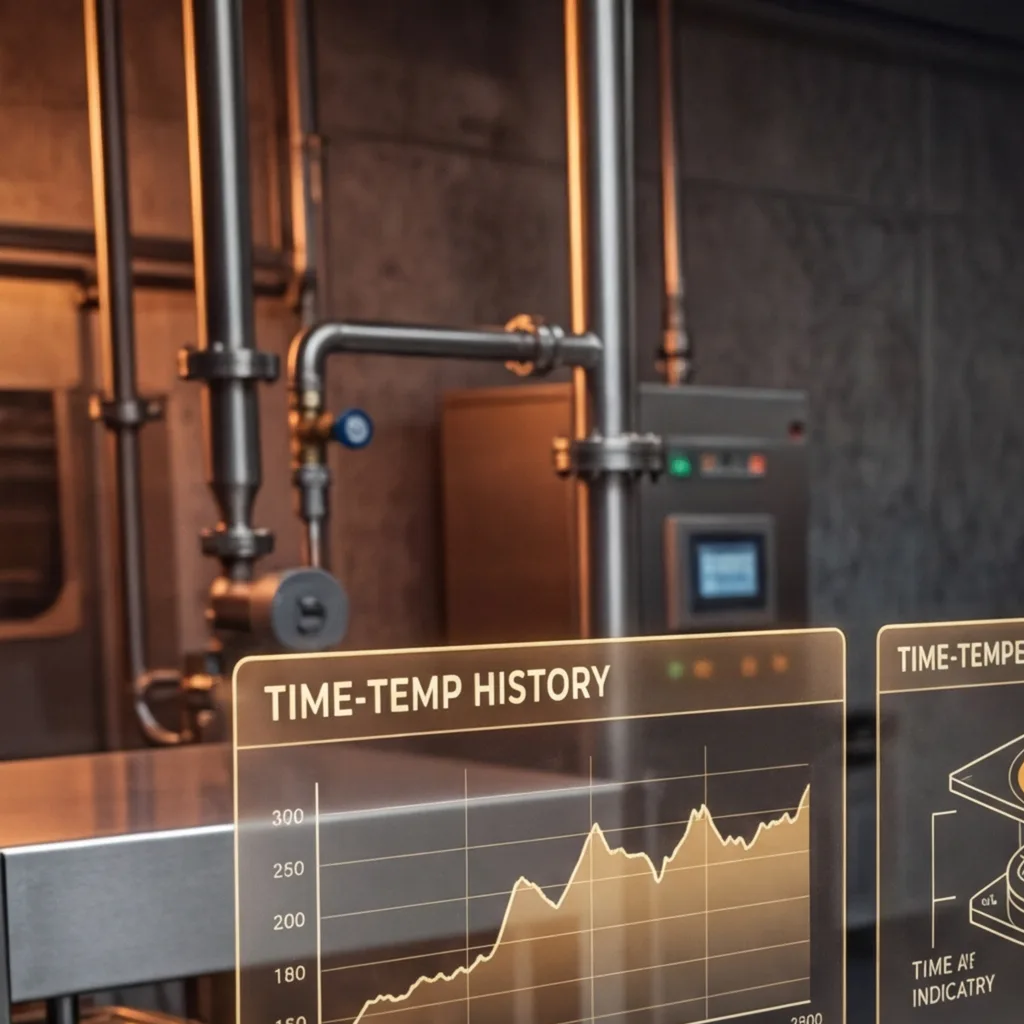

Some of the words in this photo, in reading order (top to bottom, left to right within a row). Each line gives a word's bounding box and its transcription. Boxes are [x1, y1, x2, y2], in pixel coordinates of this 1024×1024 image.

[264, 675, 463, 721] TIME-TEMP
[473, 664, 611, 707] HISTORY
[272, 807, 304, 827] 300
[273, 911, 306, 931] 200
[274, 965, 306, 985] 180
[912, 955, 953, 980] TIME
[912, 973, 996, 1008] INDICATRY
